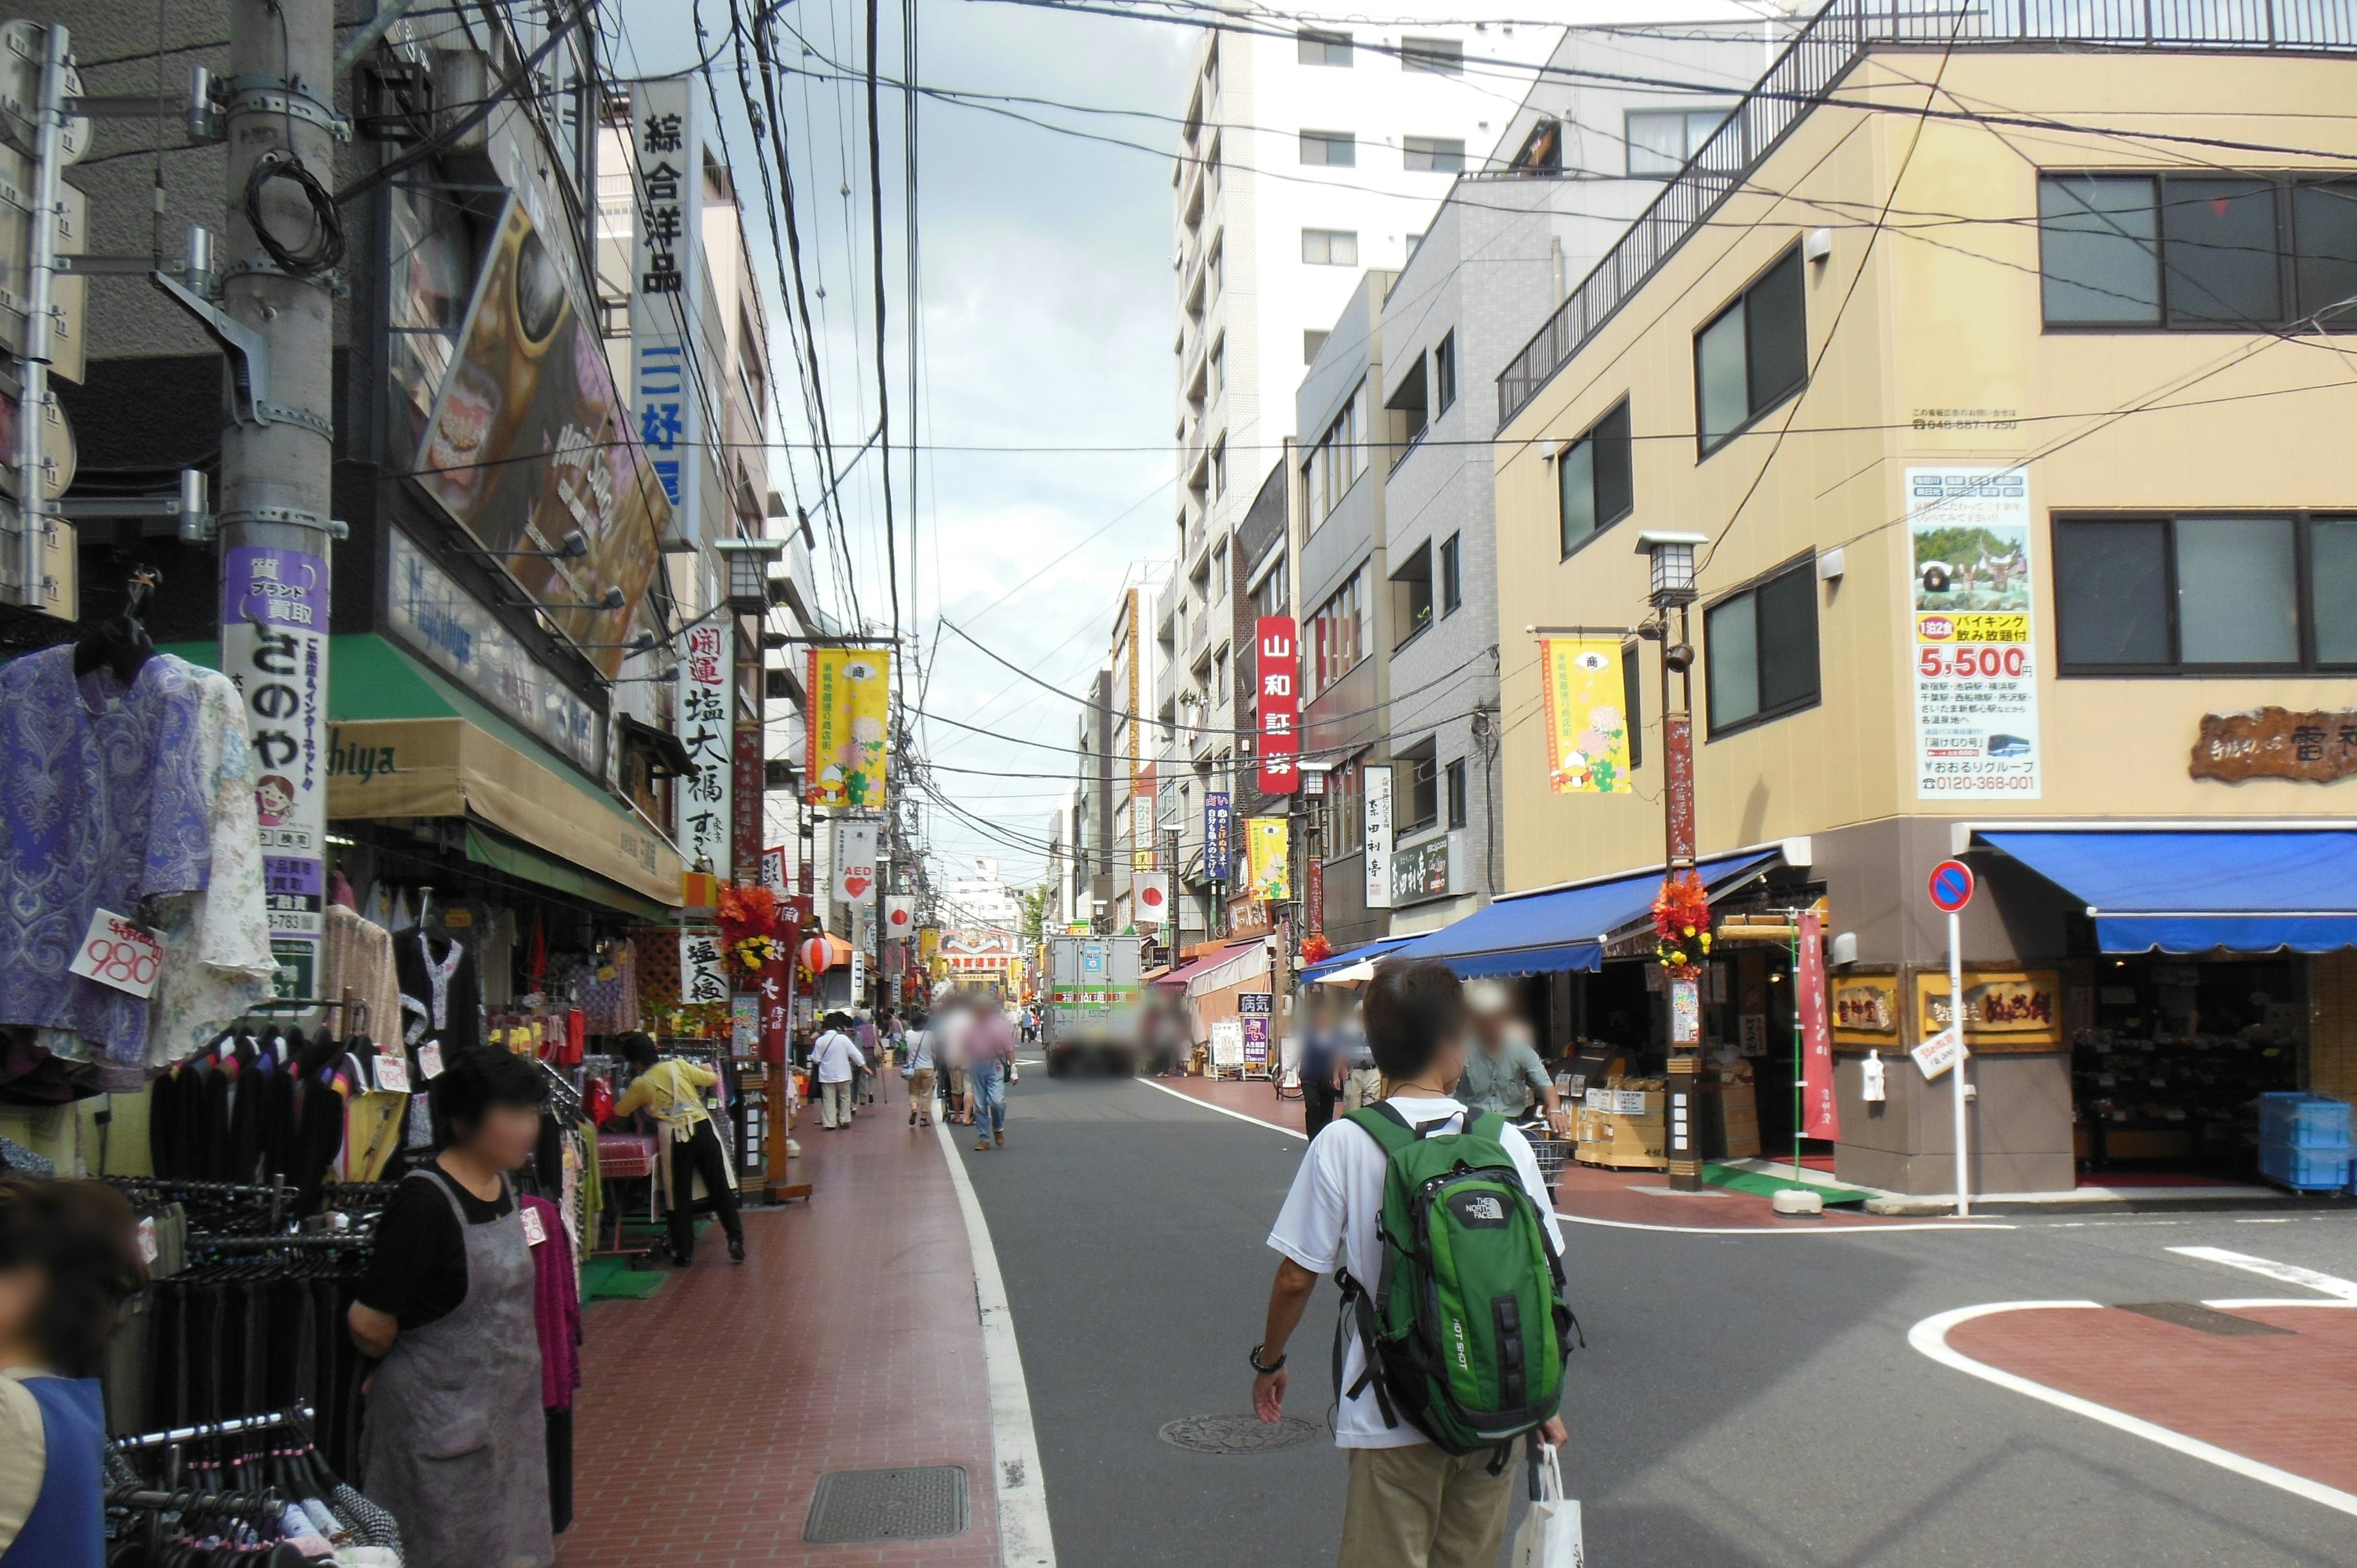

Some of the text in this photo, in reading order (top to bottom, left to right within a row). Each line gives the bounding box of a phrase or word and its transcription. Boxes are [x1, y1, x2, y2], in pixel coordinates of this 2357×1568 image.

[642, 113, 683, 293] 綜合洋品
[250, 558, 279, 580] 質
[252, 581, 305, 600] ブランド
[268, 598, 312, 625] 買取
[1919, 621, 1953, 635] 1泊2食
[1956, 616, 2025, 627] バイキング
[1956, 629, 2027, 642] 飲み放題付
[1586, 655, 1598, 668] 商
[252, 631, 301, 771] さのや
[1264, 635, 1291, 775] 山和証券
[683, 627, 729, 803] 開運 塩大福
[1921, 716, 1970, 724] 各温泉地へ
[1935, 762, 2034, 773] おおるりグループ
[1937, 776, 2034, 790] 0120-368-001
[1206, 794, 1229, 807] 占い
[770, 854, 779, 882] アイス
[844, 867, 872, 876] AED
[687, 940, 727, 1002] 塩大福
[1062, 991, 1126, 1003] 福山通運
[1241, 995, 1269, 1012] 病気
[1245, 1019, 1265, 1041] 占い
[1453, 1318, 1468, 1371] HOT SHOT
